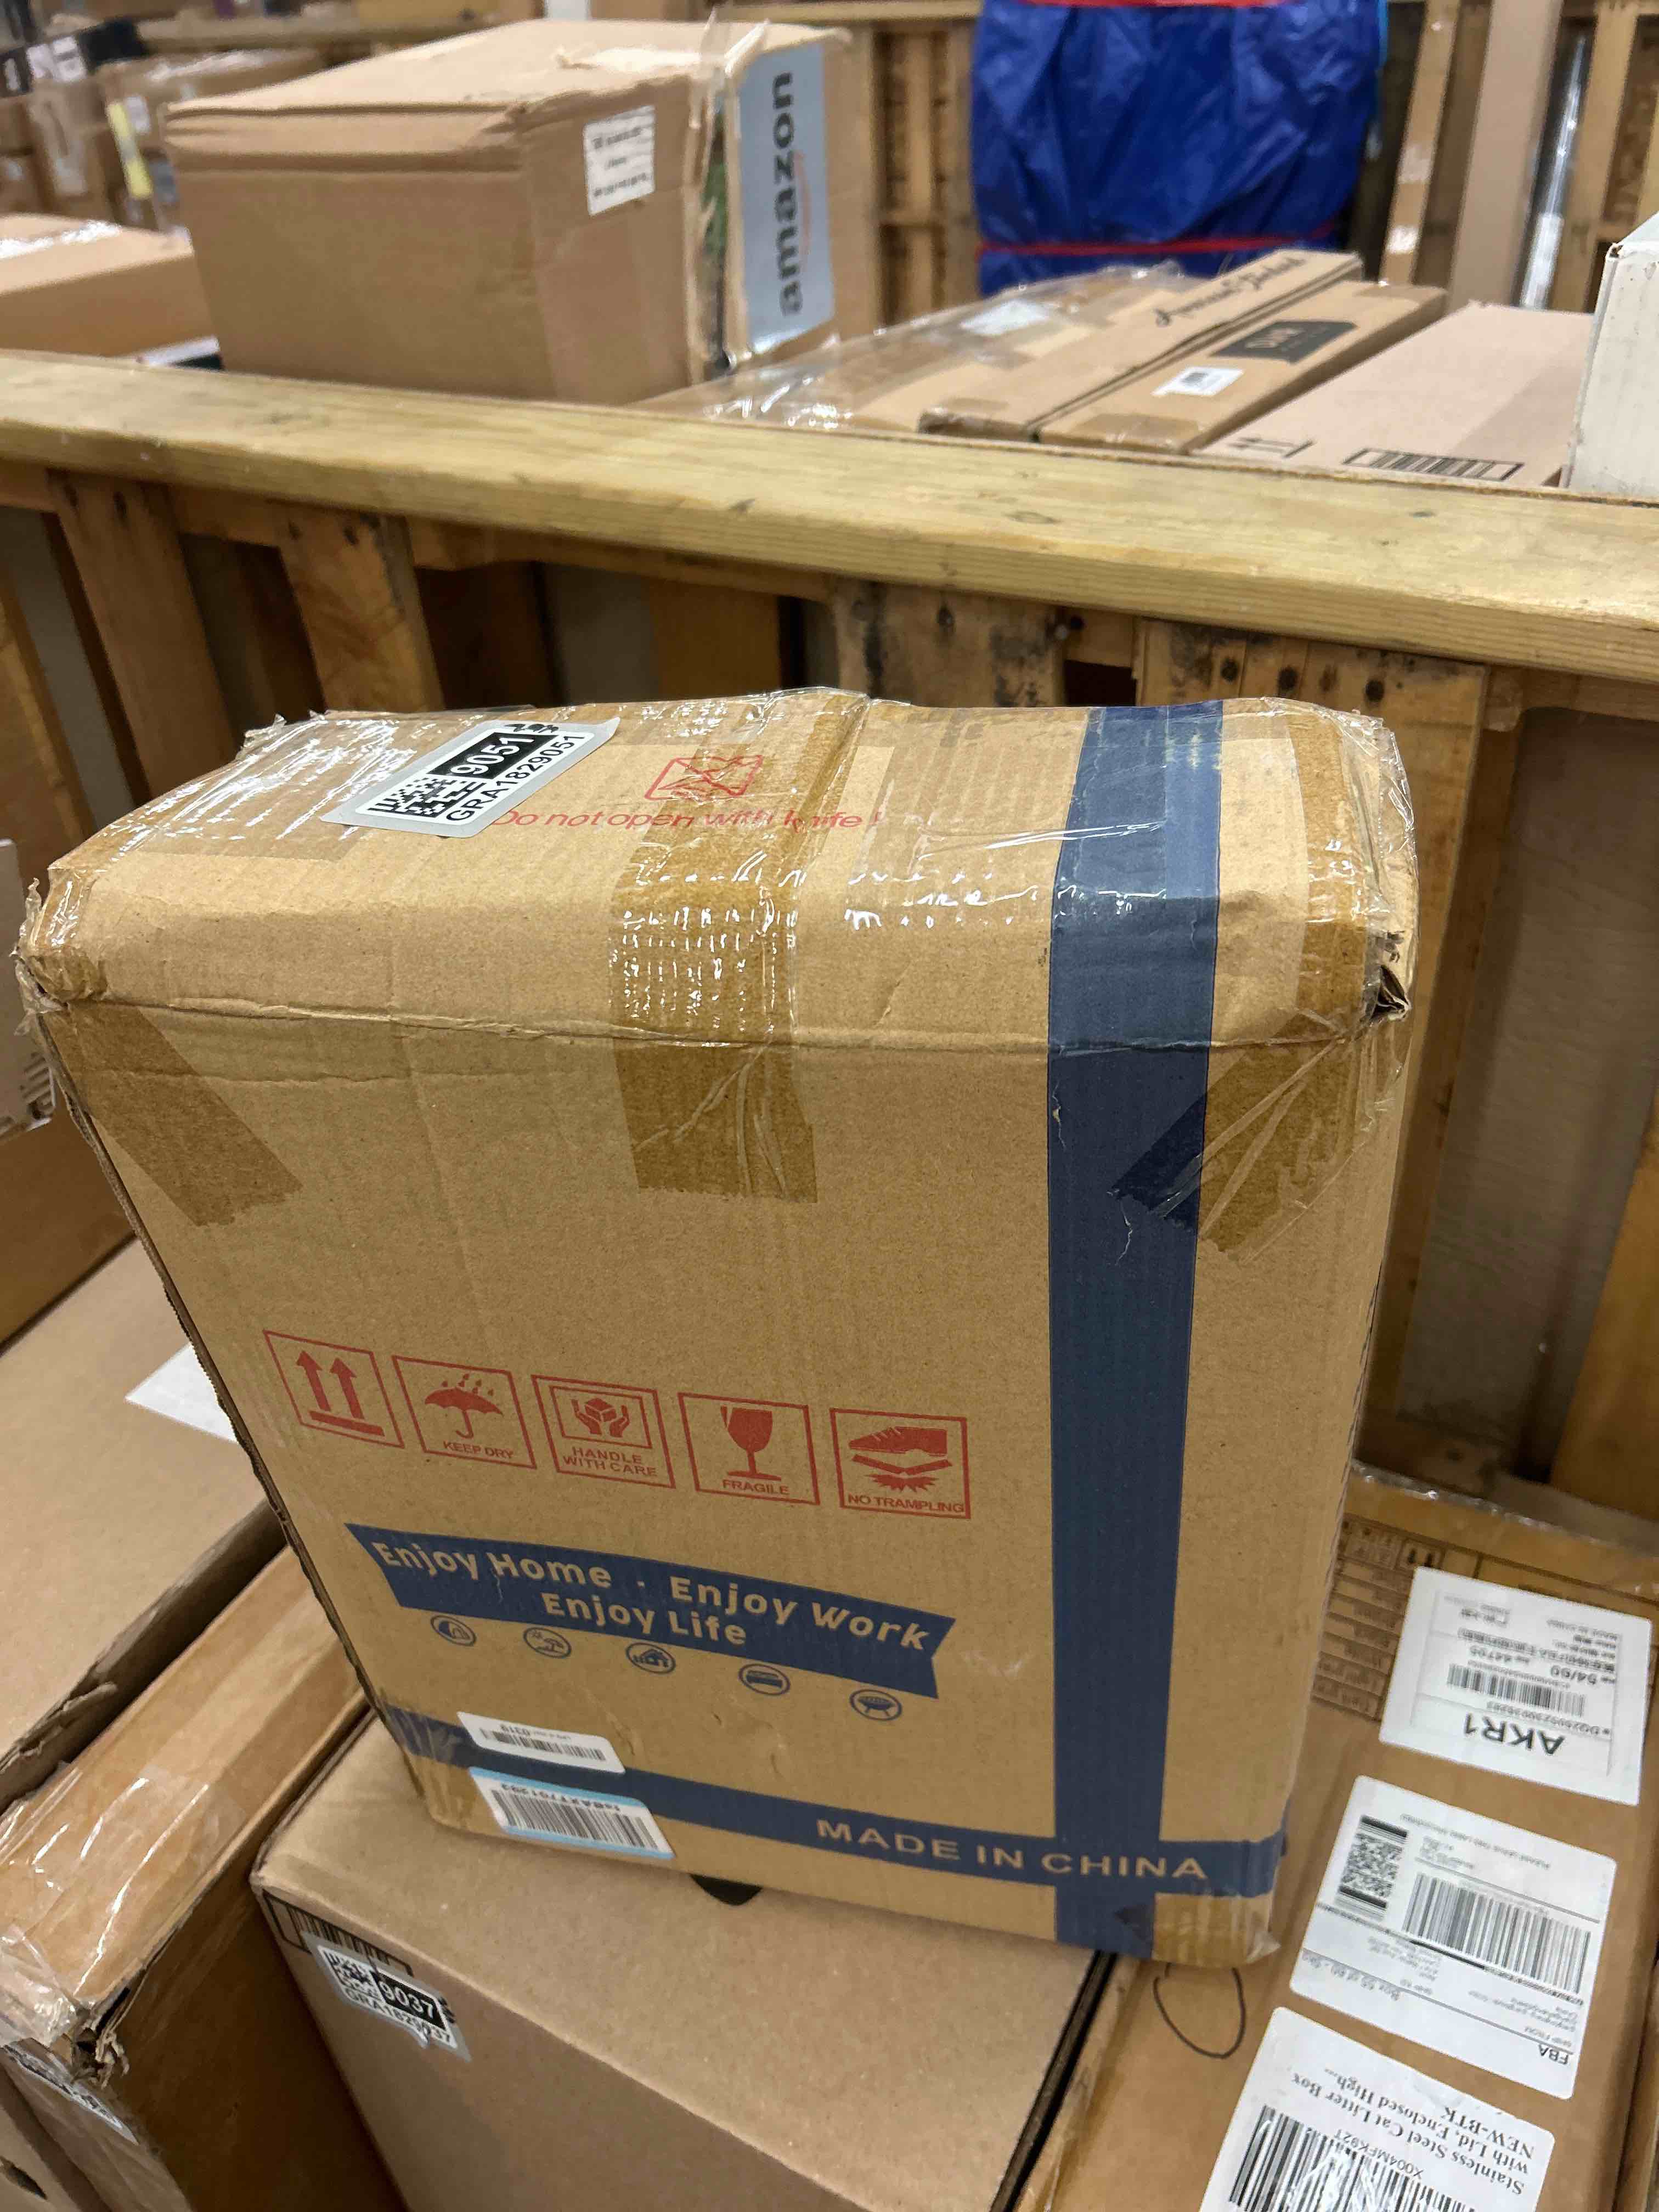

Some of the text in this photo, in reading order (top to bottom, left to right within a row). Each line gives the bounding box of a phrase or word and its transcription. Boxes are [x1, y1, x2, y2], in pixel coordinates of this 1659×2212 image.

[772, 71, 804, 317] amazon
[449, 737, 535, 775] 9051
[445, 735, 586, 822] GRA1829051
[545, 811, 603, 826] not
[607, 811, 695, 830] open
[704, 808, 773, 826] with
[443, 1441, 515, 1459] KEEP DRY
[563, 1455, 659, 1477] WITH CARE
[572, 1446, 642, 1464] HANDLE
[722, 1479, 790, 1496] FRAGILE
[848, 1494, 966, 1513] NO TRAMPLING
[371, 1541, 481, 1581] Enjoy
[486, 1552, 612, 1589] Home
[669, 1575, 799, 1626] Enjoy
[811, 1601, 932, 1651] Work
[540, 1592, 748, 1647] Enjoy Life
[1463, 1711, 1566, 1757] AKR1
[816, 1818, 1210, 1880] MADE IN CHINA
[378, 1980, 434, 2019] 9037
[1537, 2042, 1571, 2066] FBA
[1290, 2072, 1525, 2196] Stainless Steel Cat Litter Box
[1377, 2096, 1449, 2140] Enclosed
[1443, 2106, 1535, 2160] NEW-BTK
[1455, 2128, 1487, 2158] Lid,
[1492, 2149, 1530, 2176] with
